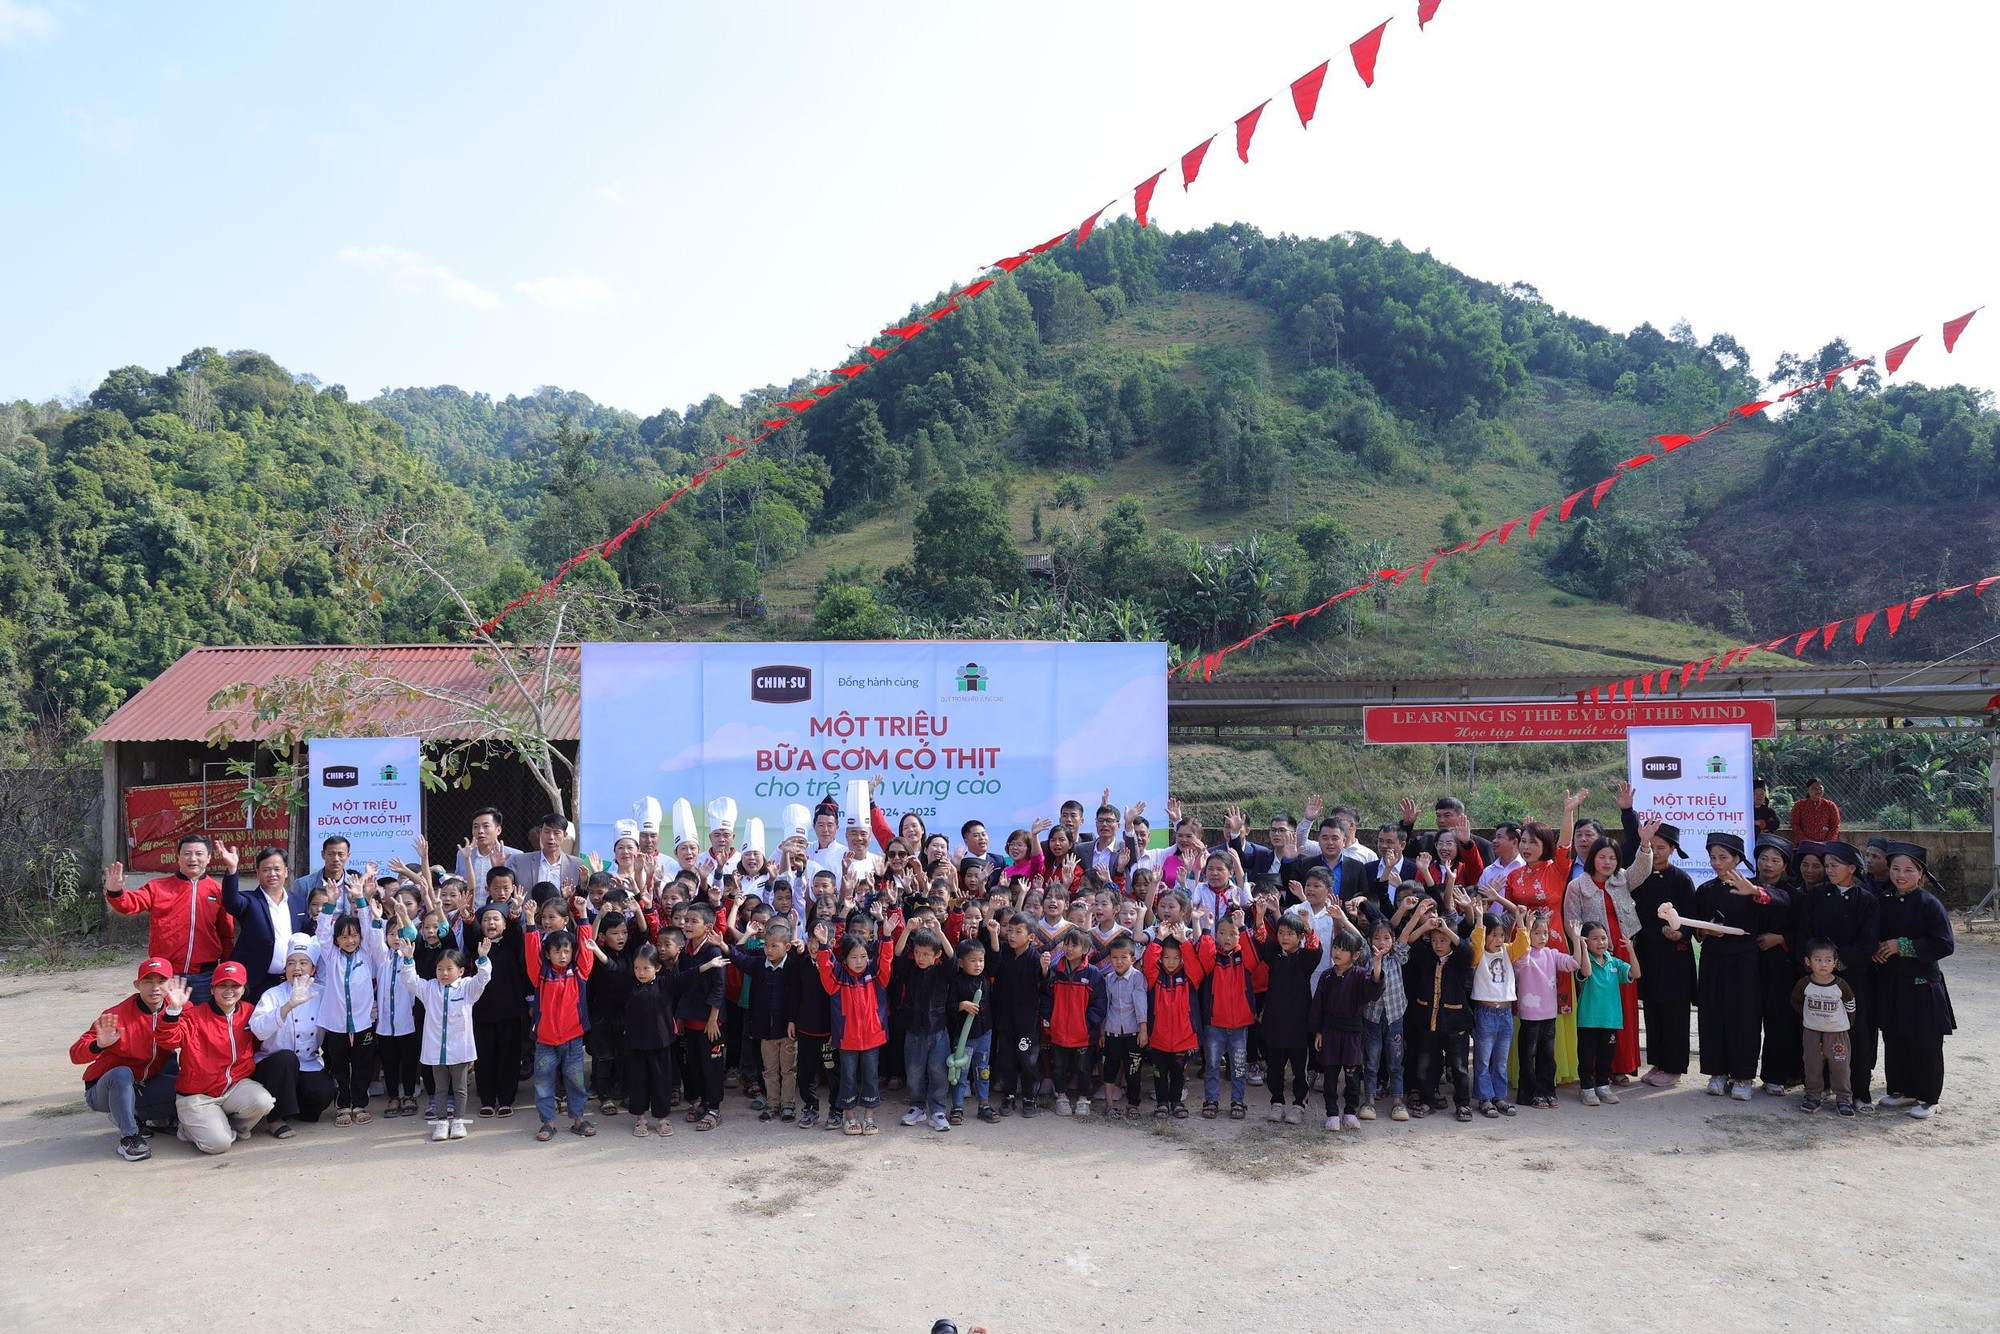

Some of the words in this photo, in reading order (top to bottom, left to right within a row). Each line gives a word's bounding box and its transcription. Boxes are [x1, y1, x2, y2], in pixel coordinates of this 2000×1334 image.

[756, 676, 806, 689] CHIN-SU
[838, 675, 865, 689] Đồng
[867, 676, 893, 687] hành
[894, 676, 919, 689] cùng
[1392, 709, 1494, 724] LEARNING
[1499, 709, 1517, 722] IS
[1522, 709, 1562, 722] THE
[1567, 708, 1606, 721] EYE
[1610, 707, 1637, 720] OF
[1641, 706, 1684, 720] THE
[1690, 705, 1746, 719] MIND
[810, 710, 870, 744] MỘT
[874, 709, 948, 744] TRIỆU
[1454, 727, 1486, 740] Học
[1490, 727, 1514, 739] tập
[1519, 727, 1534, 737] là
[1538, 729, 1563, 737] con
[1568, 725, 1598, 736] mắt
[756, 743, 817, 772] BỮA
[821, 746, 888, 771] CƠM
[895, 741, 937, 770] CÓ
[941, 747, 1001, 776] THỊT
[1645, 763, 1678, 771] CHIN-SU
[325, 771, 355, 780] CHIN-SU
[755, 776, 800, 797] cho
[806, 773, 841, 797] trẻ
[892, 773, 951, 801] vùng
[956, 779, 1001, 795] cao
[332, 799, 360, 814] MỘT
[363, 798, 397, 813] TRIỆU
[1653, 792, 1683, 809] MỘT
[1687, 792, 1727, 809] TRIỆU
[318, 814, 341, 826] BỮA
[343, 815, 368, 825] CƠM
[370, 813, 386, 824] CÓ
[388, 814, 412, 826] THỊT
[1638, 809, 1662, 821] BỮA
[1665, 811, 1694, 821] CƠM
[1696, 809, 1715, 821] CÓ
[1717, 812, 1744, 824] THỊT
[370, 829, 394, 839] vùng
[395, 829, 414, 837] cao
